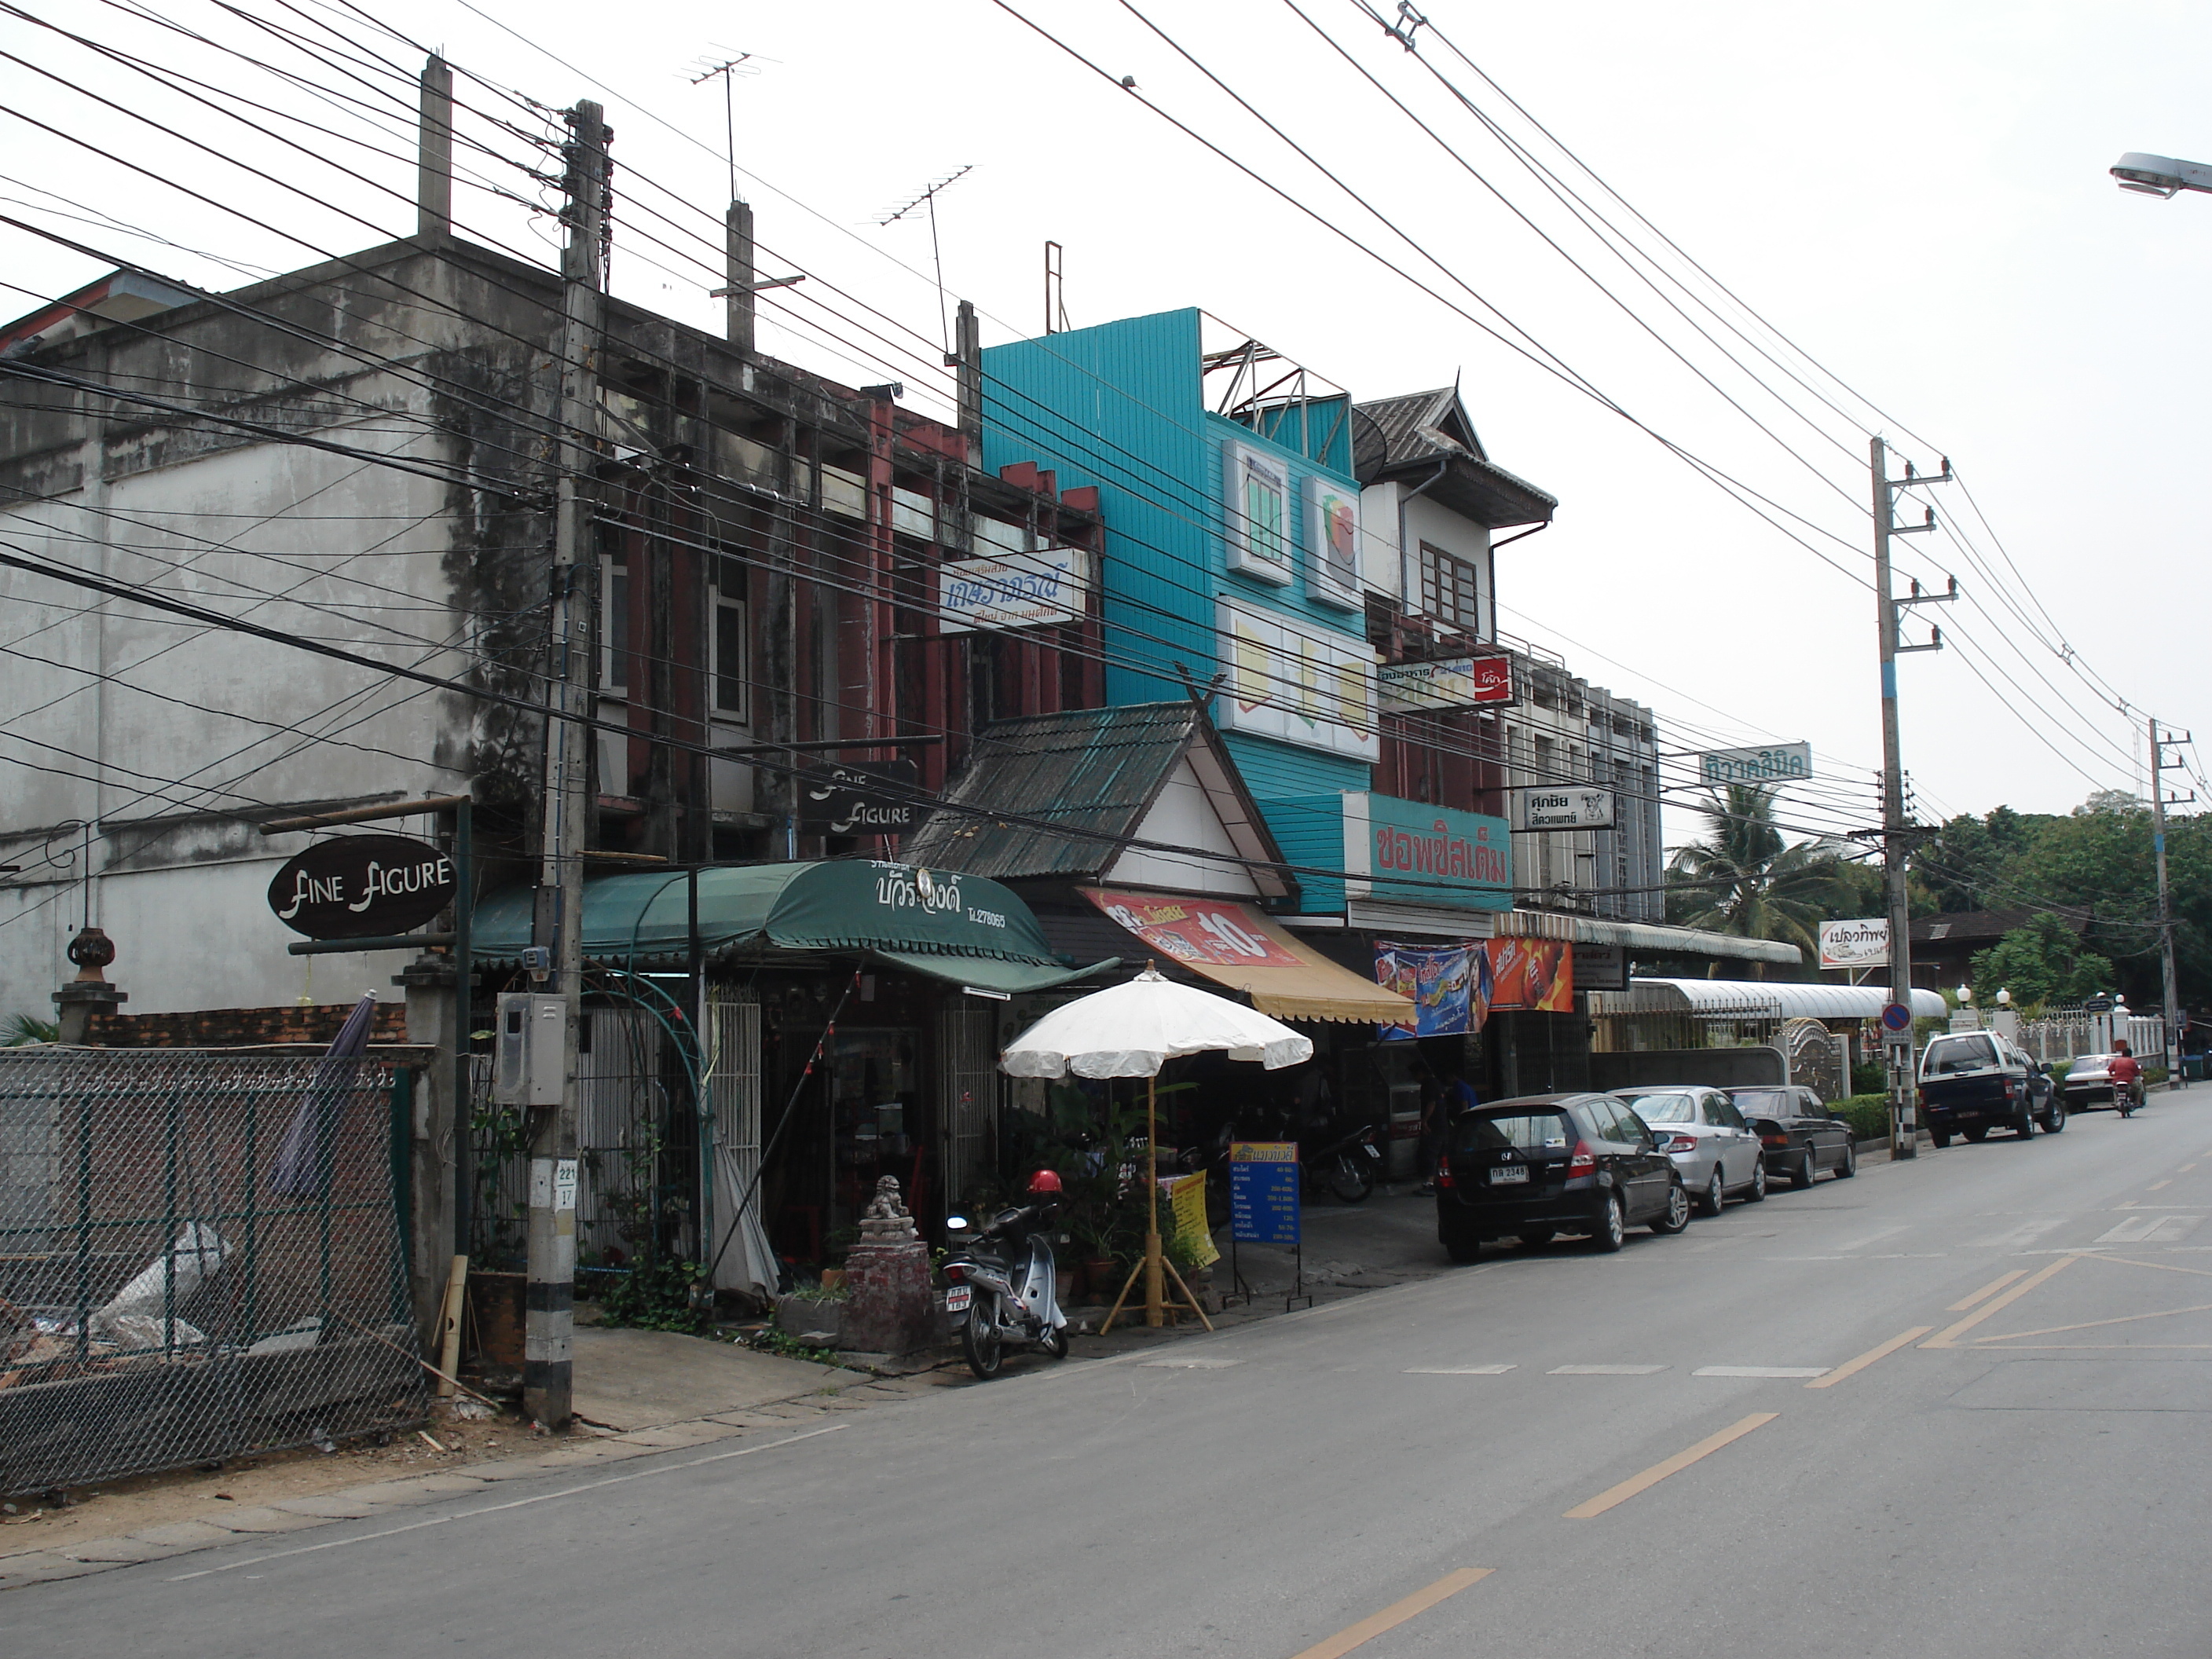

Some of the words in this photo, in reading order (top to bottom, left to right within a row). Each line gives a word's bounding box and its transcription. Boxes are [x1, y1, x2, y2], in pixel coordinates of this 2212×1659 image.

[1531, 794, 1569, 811] ศุภชัย
[830, 801, 910, 833] FIGURE
[278, 869, 344, 920] FINE
[348, 860, 451, 913] FIGURE
[1196, 910, 1268, 958] 10
[559, 1168, 576, 1180] 221
[562, 1190, 572, 1202] 17
